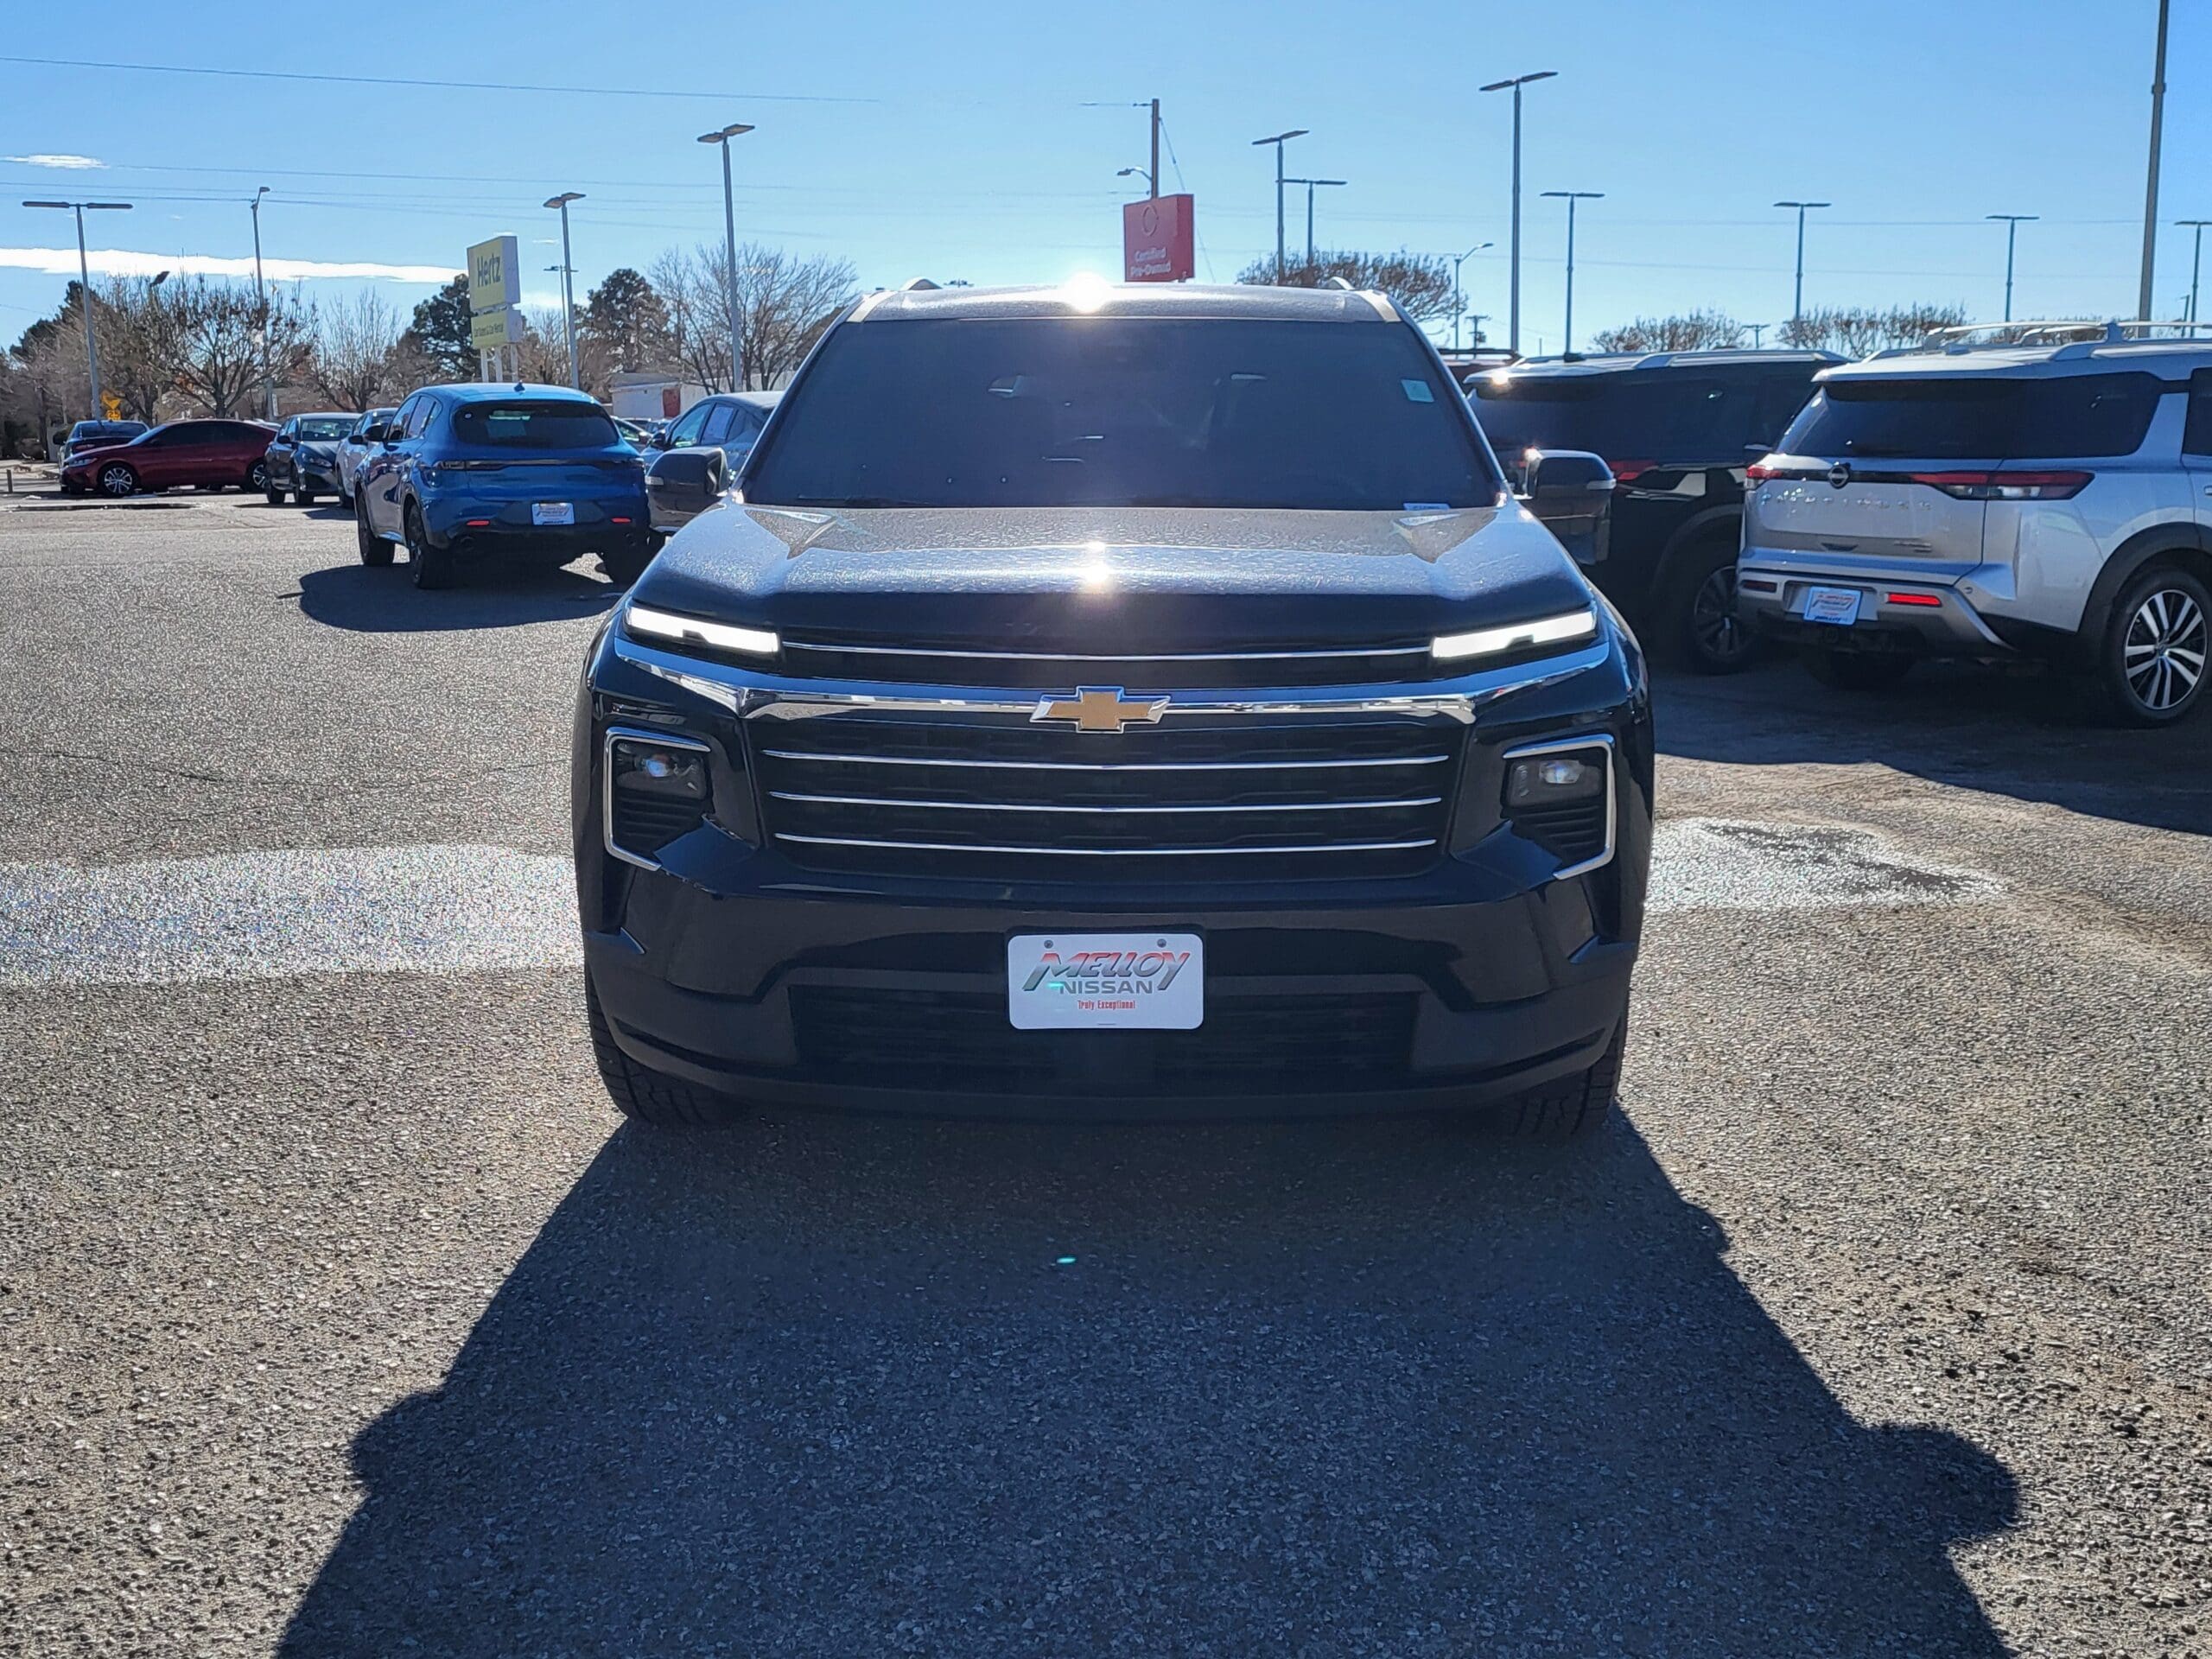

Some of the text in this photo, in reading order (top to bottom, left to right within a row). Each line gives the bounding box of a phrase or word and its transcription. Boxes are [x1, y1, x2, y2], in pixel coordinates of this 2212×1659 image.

[477, 253, 500, 288] Hertz
[1022, 952, 1190, 991] MELLOY
[1059, 981, 1154, 994] NISSAN
[1077, 1000, 1136, 1010] Truly Exceptional
